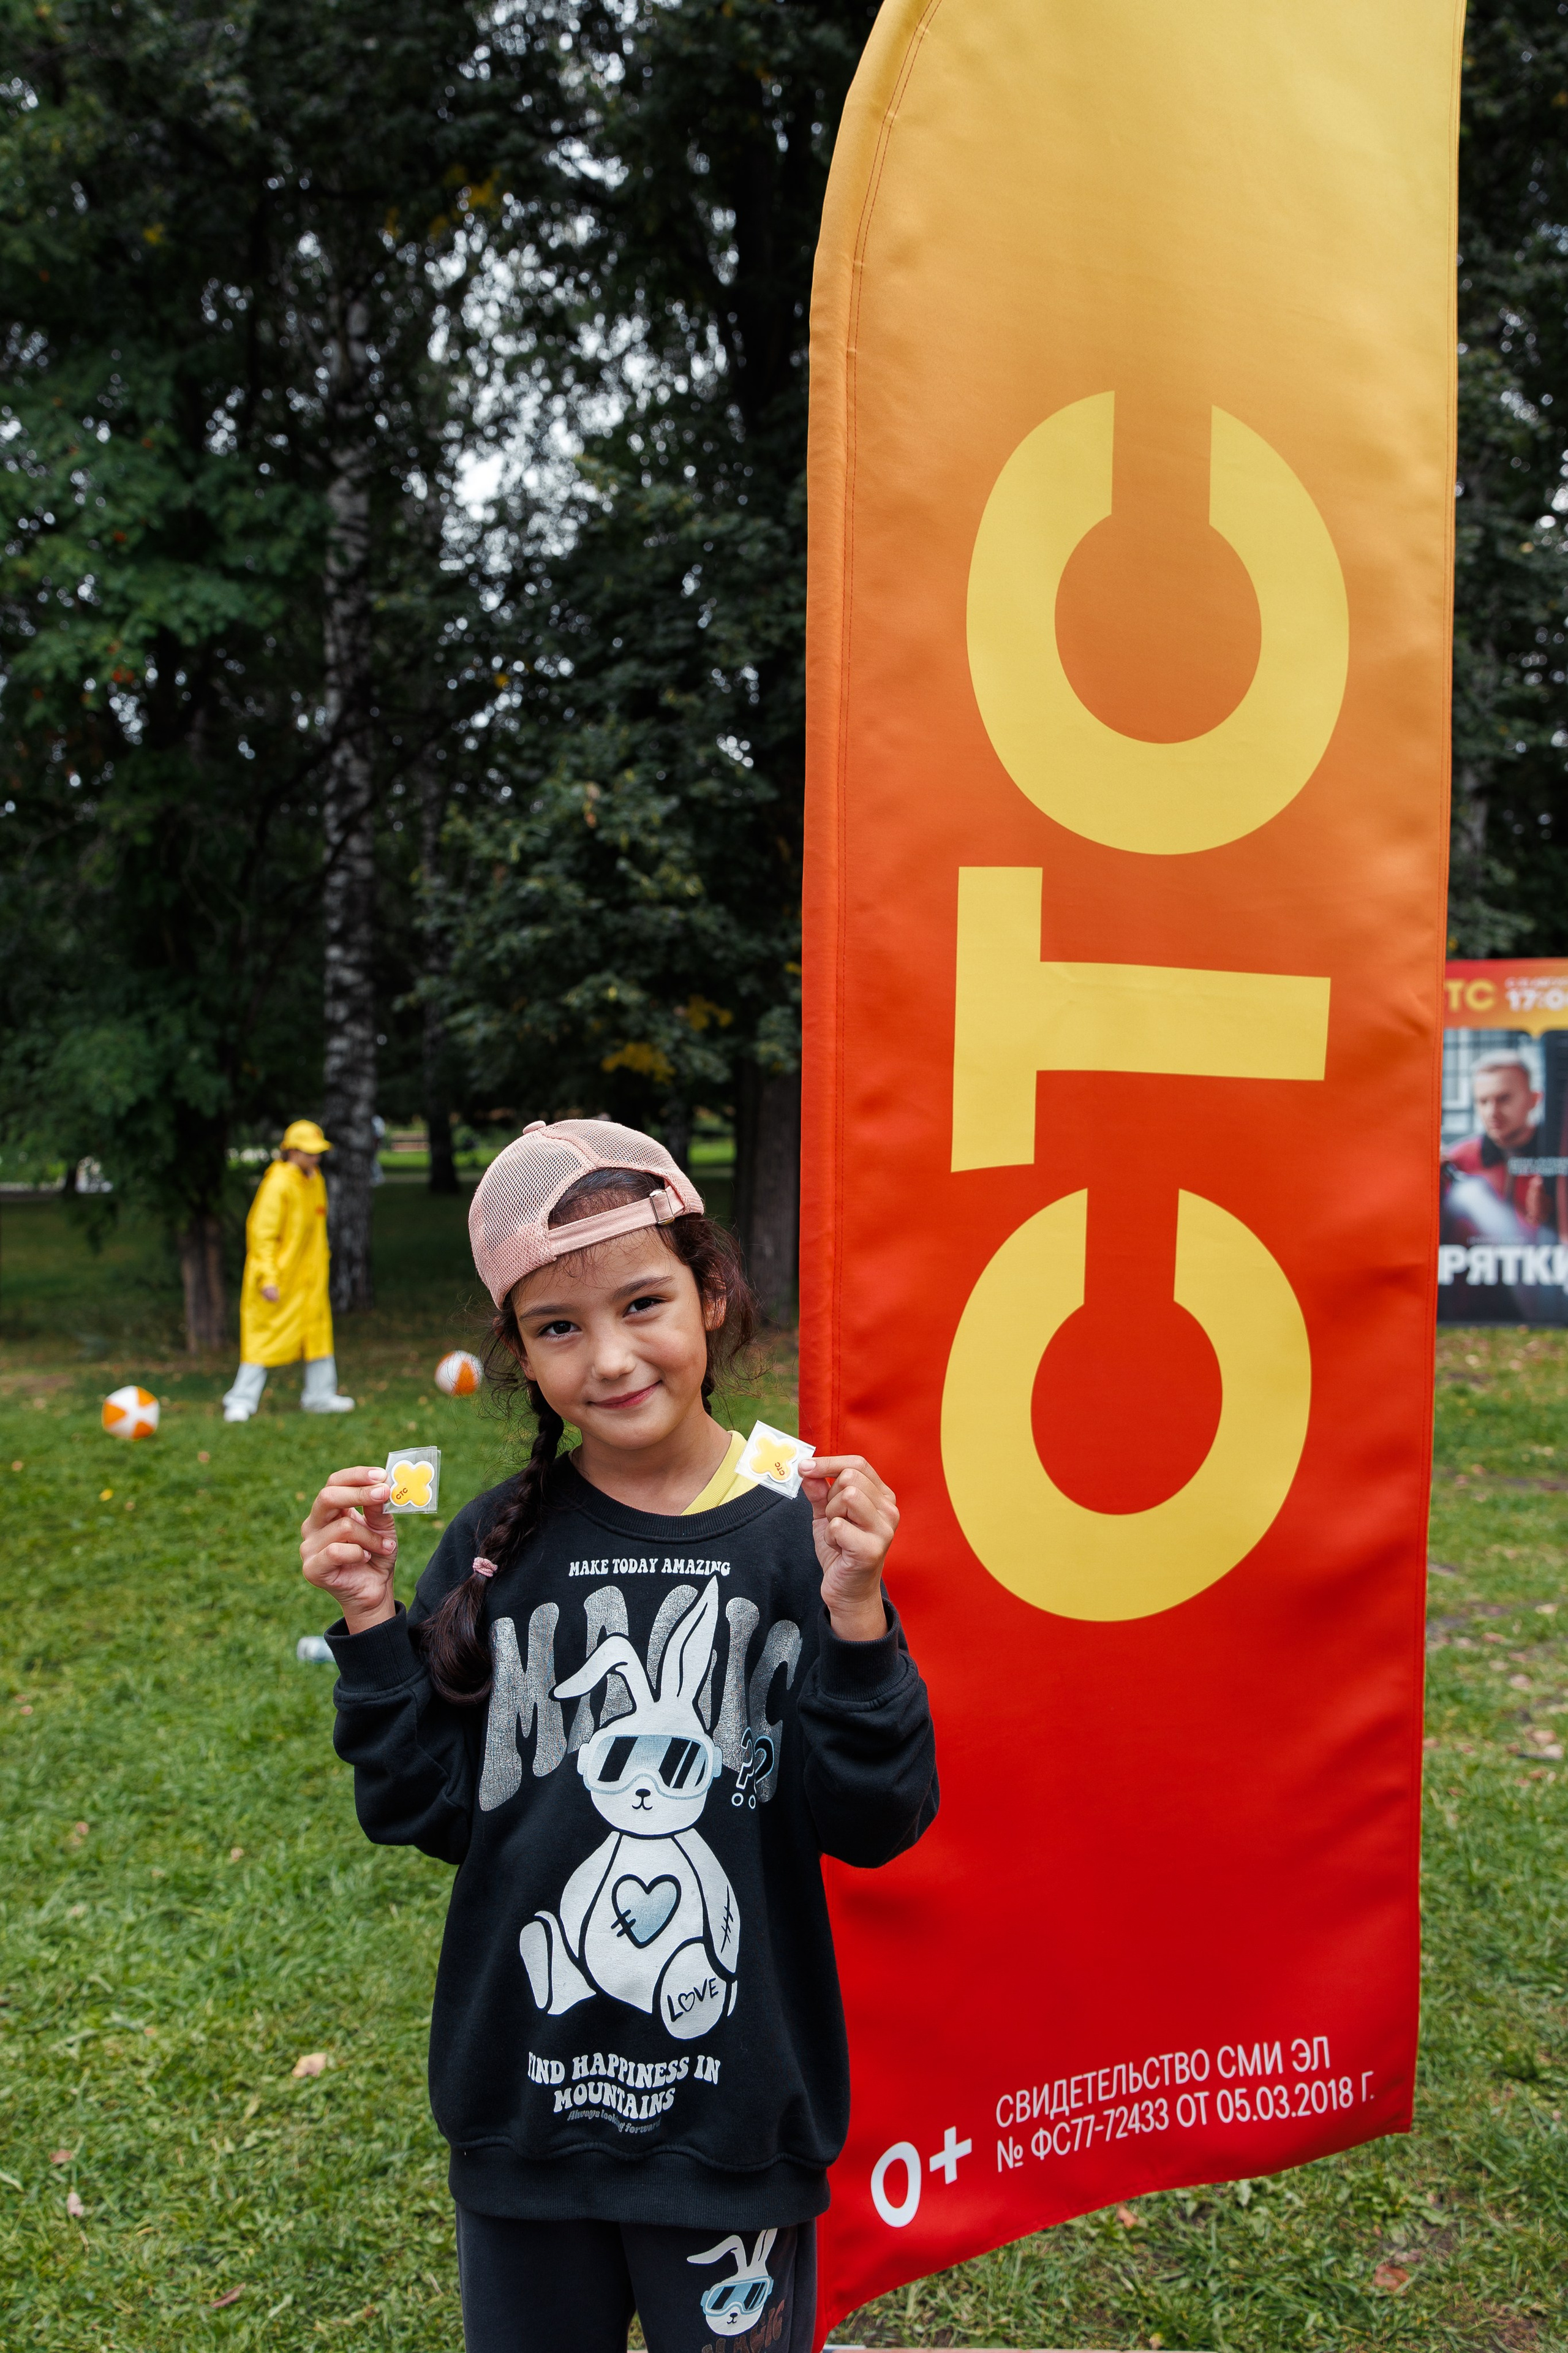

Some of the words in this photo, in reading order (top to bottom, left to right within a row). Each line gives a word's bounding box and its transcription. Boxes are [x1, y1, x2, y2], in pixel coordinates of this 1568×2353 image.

[941, 390, 1349, 1622] СТС
[396, 1487, 409, 1500] СТС
[568, 1558, 609, 1577] MAKE
[612, 1558, 658, 1574] TODAY
[661, 1558, 731, 1576] AMAZING
[527, 2051, 565, 2085] FIND
[571, 2052, 690, 2088] HAPPINESS
[693, 2055, 721, 2085] IN
[995, 2048, 1210, 2128] СВИДЕТЕЛЬСТВО
[1216, 2041, 1284, 2079] СМИ
[1291, 2036, 1330, 2073] ЭЛ
[553, 2081, 676, 2120] MOUNTAINS
[567, 2109, 600, 2121] Always
[1030, 2097, 1170, 2160] ФС77-72433
[1176, 2091, 1210, 2128] ОТ
[1216, 2076, 1354, 2124] 05.03.2018
[870, 2126, 973, 2228] 0+
